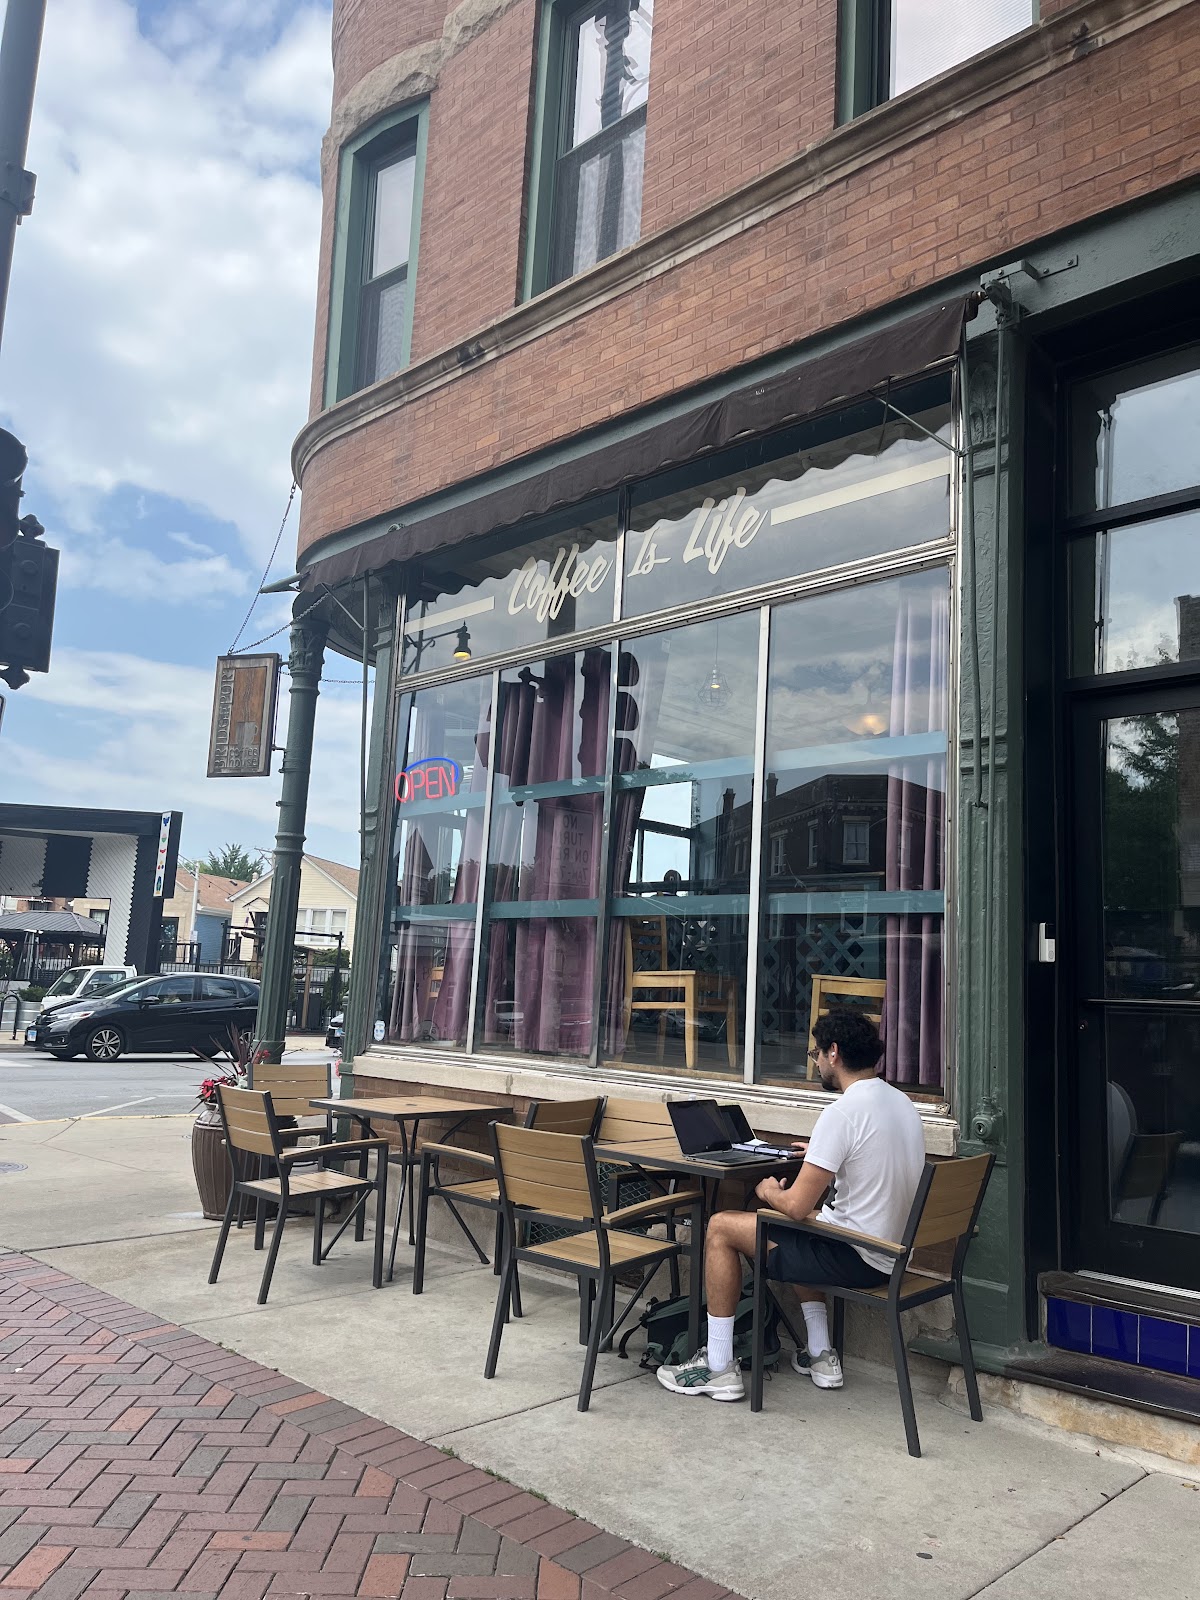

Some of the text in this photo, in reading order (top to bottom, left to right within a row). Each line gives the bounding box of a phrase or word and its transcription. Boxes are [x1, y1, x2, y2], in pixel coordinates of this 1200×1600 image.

[508, 487, 768, 623] Coffee Is Life
[395, 764, 456, 803] OPEN
